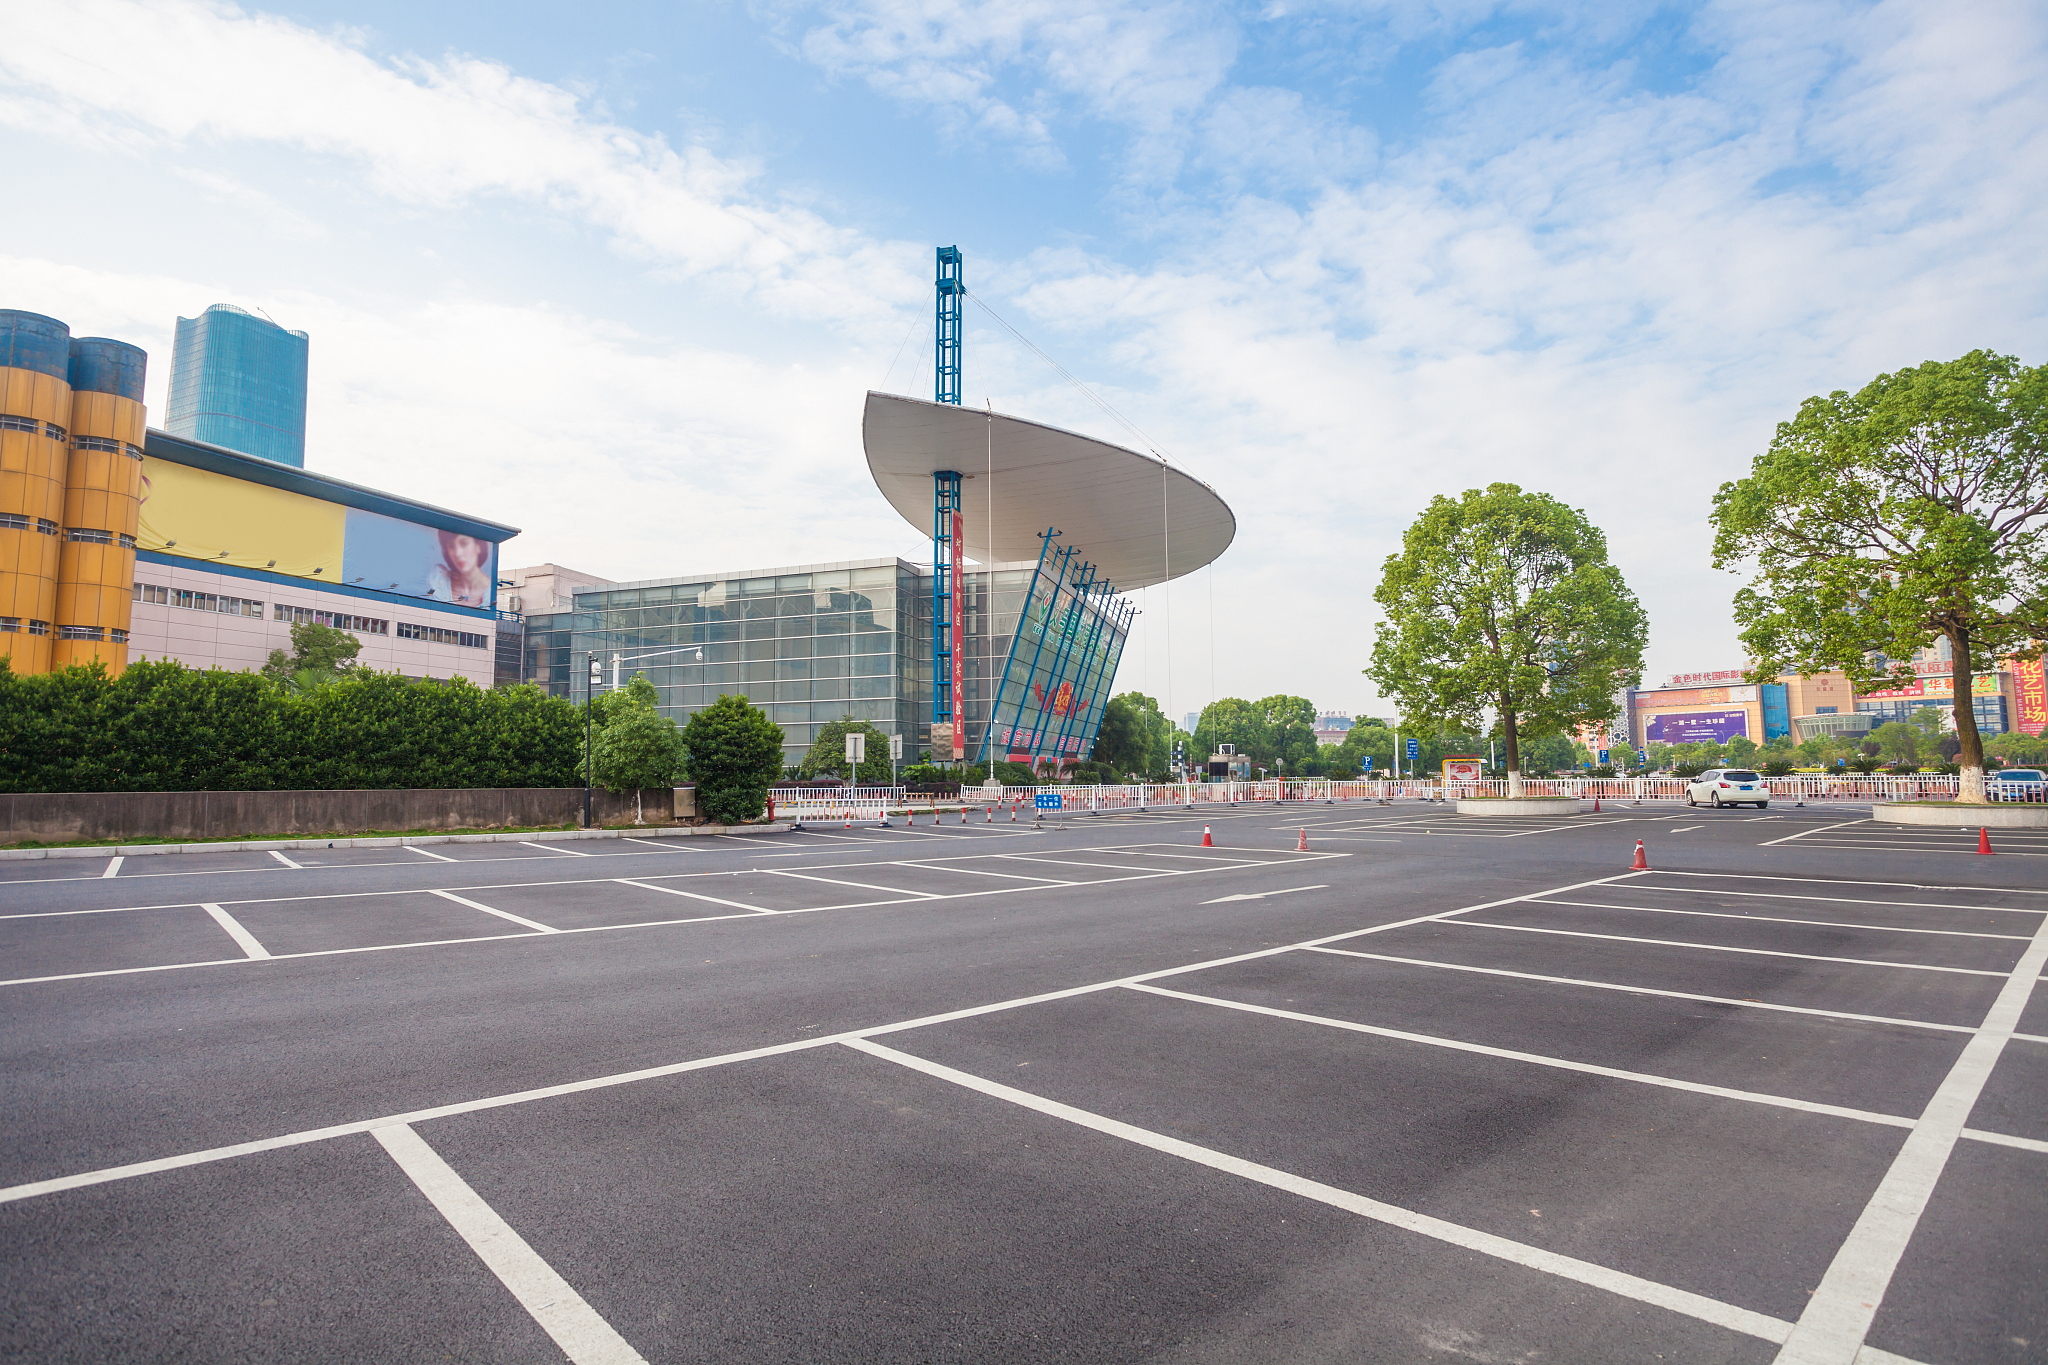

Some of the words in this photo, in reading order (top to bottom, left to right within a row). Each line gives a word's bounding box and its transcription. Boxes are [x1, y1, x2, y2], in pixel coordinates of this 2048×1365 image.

[1928, 676, 1991, 690] 华馨艺
[2020, 659, 2046, 723] 花艺市场
[1601, 750, 1607, 758] P
[1365, 756, 1371, 765] P
